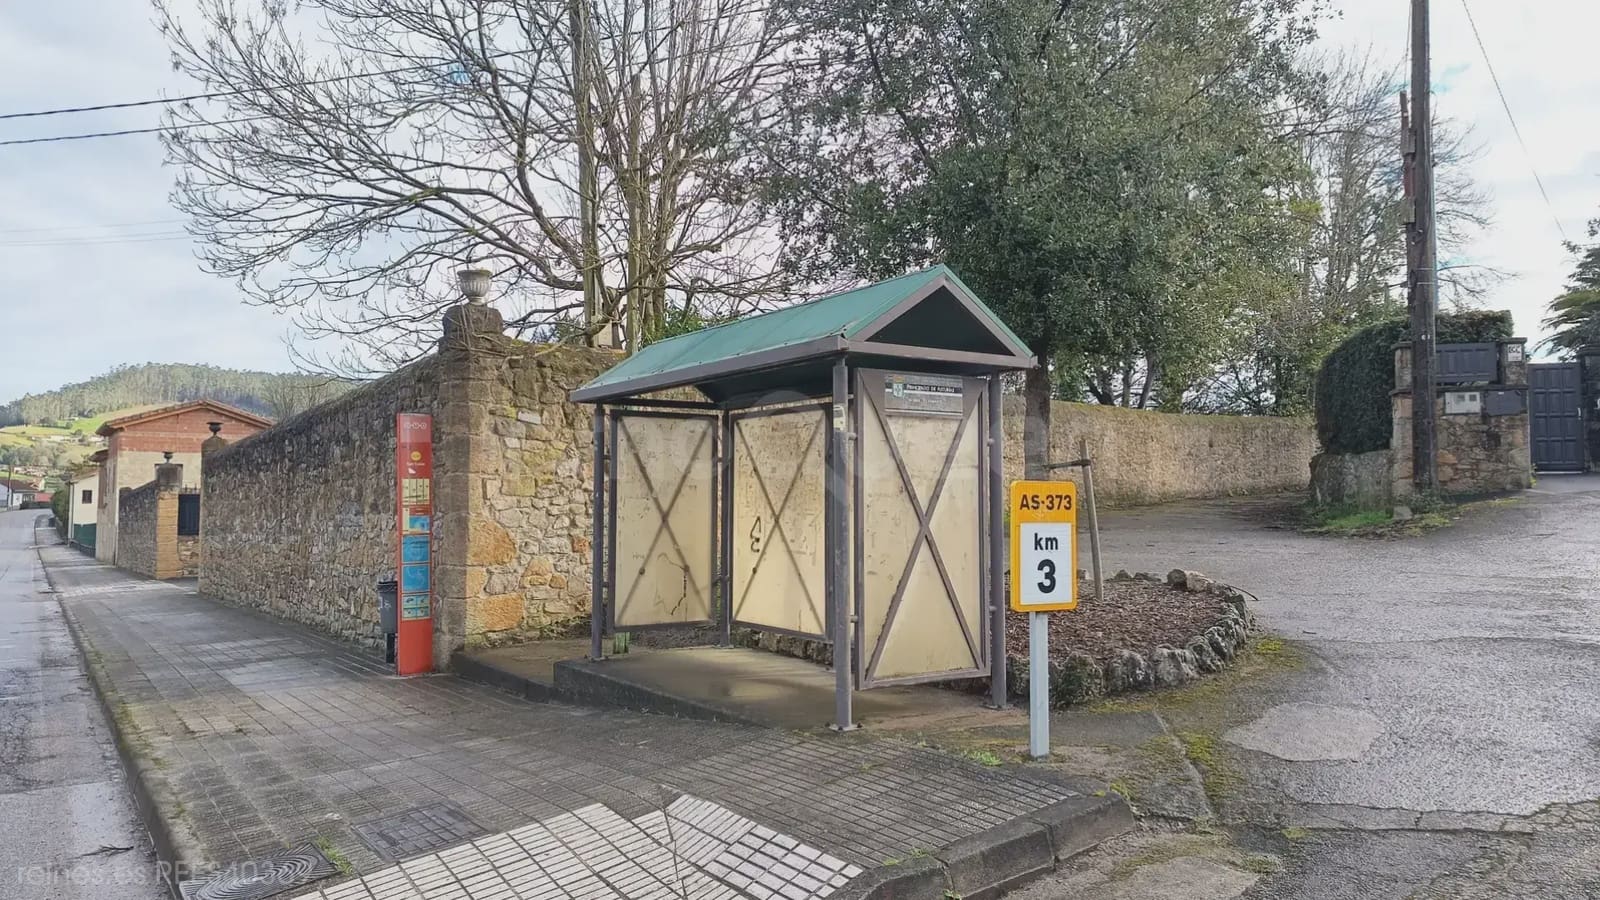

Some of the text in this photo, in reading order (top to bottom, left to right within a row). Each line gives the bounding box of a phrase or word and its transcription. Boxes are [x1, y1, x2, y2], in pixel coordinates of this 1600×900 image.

[1020, 494, 1072, 510] AS-373
[1034, 532, 1058, 551] km
[1037, 559, 1056, 594] 3
